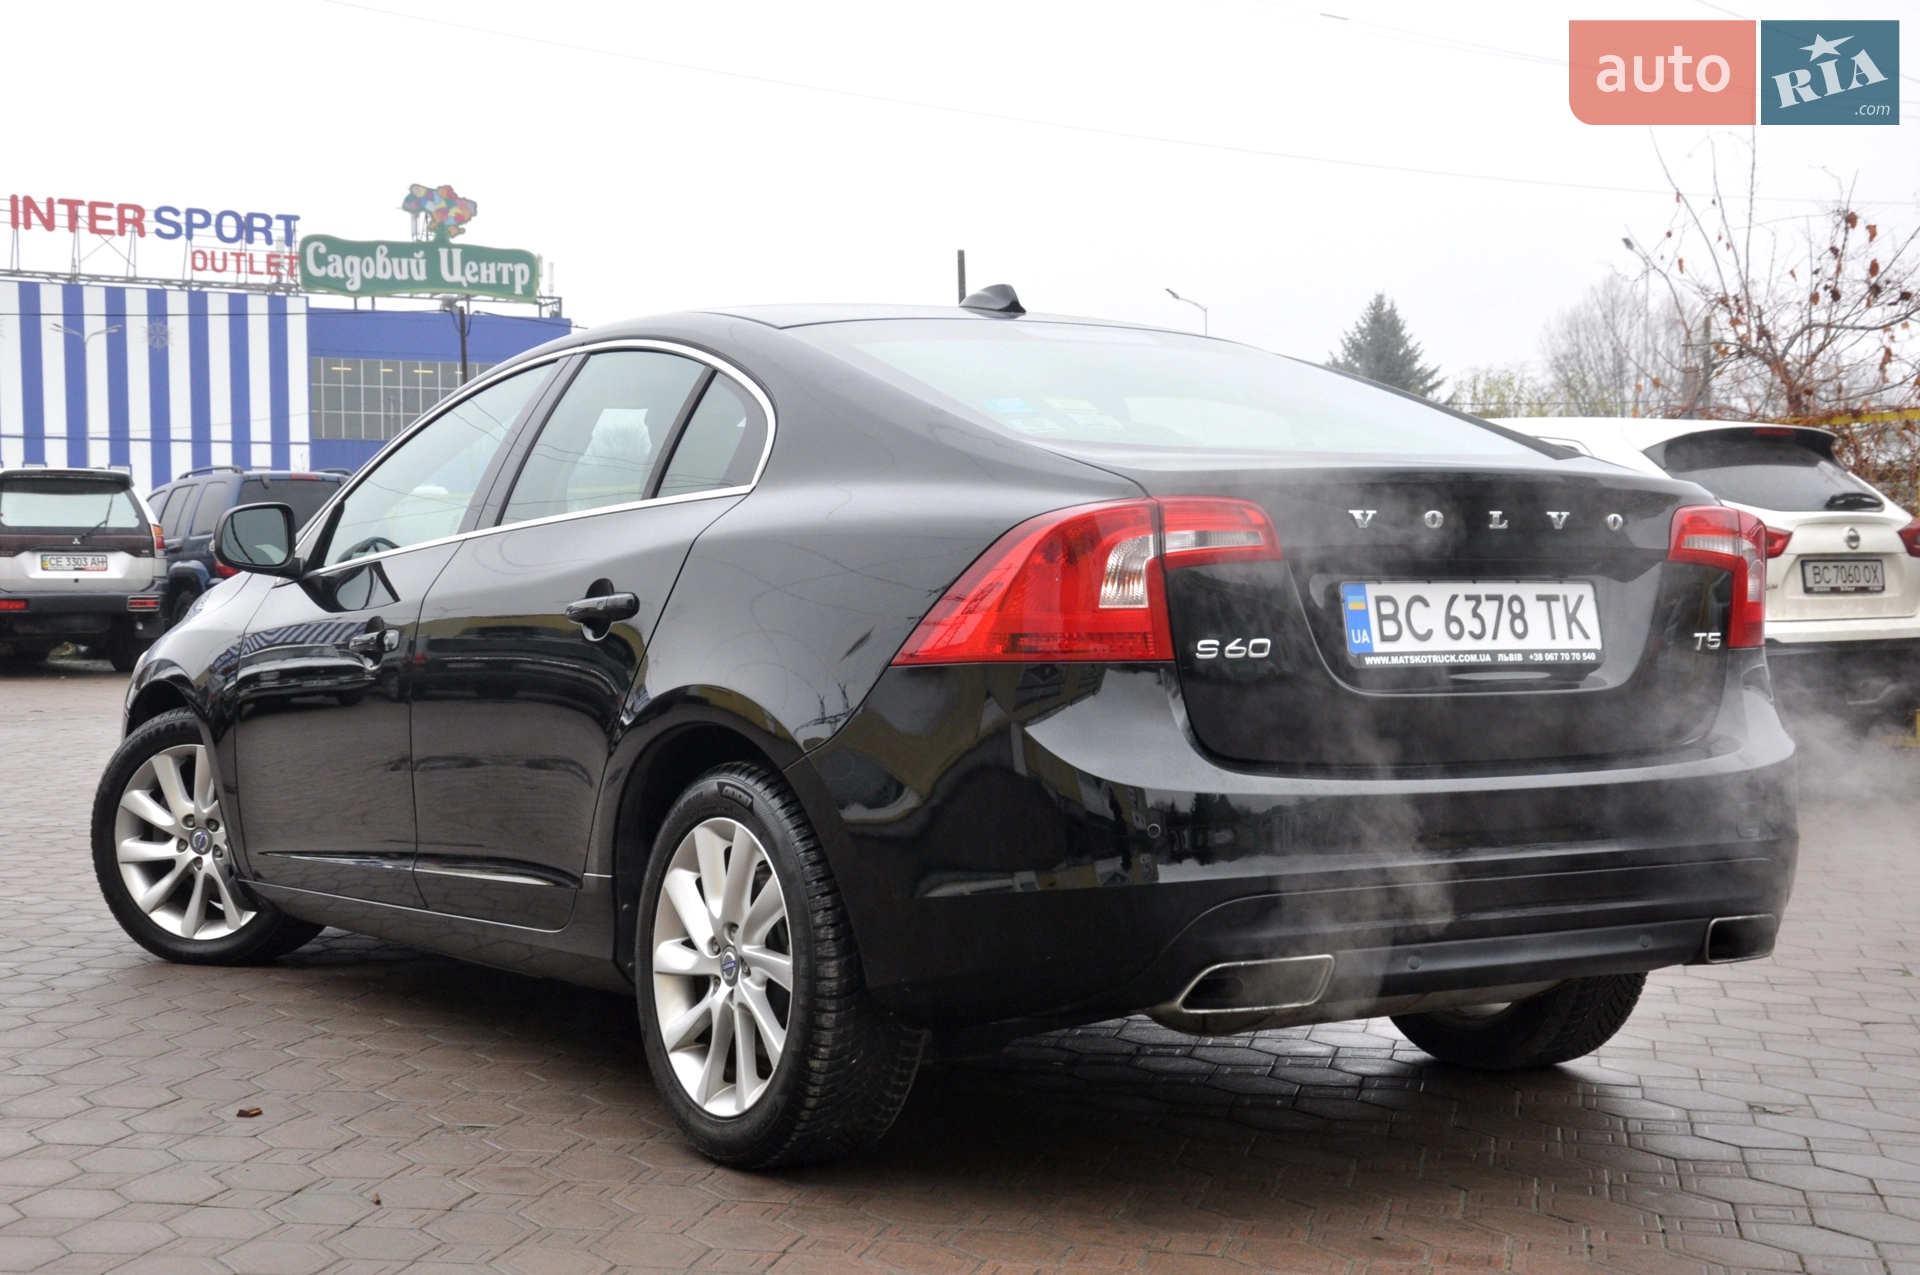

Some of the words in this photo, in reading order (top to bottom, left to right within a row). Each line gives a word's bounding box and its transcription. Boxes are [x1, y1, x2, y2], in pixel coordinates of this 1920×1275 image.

[9, 194, 146, 238] INTER
[154, 205, 301, 247] SPORT
[191, 249, 299, 278] OUTLET
[305, 241, 427, 292] Садовий
[438, 247, 531, 295] Центр
[1349, 509, 1624, 532] VOLVO
[1812, 565, 1831, 585] BC
[1833, 564, 1861, 584] 7060
[1863, 564, 1880, 583] OX
[1374, 594, 1434, 643] BC
[1445, 594, 1529, 641] 6378
[1536, 594, 1590, 641] TK
[1195, 637, 1271, 660] S60
[1351, 629, 1371, 645] UA
[1693, 632, 1722, 651] T5
[1364, 654, 1492, 666] WWW.MATSKOTRUCK.COM.UA
[1528, 653, 1543, 661] +38
[1544, 653, 1559, 662] 067
[1560, 653, 1570, 662] 70
[1571, 653, 1581, 662] 70
[1582, 652, 1596, 661] 540
